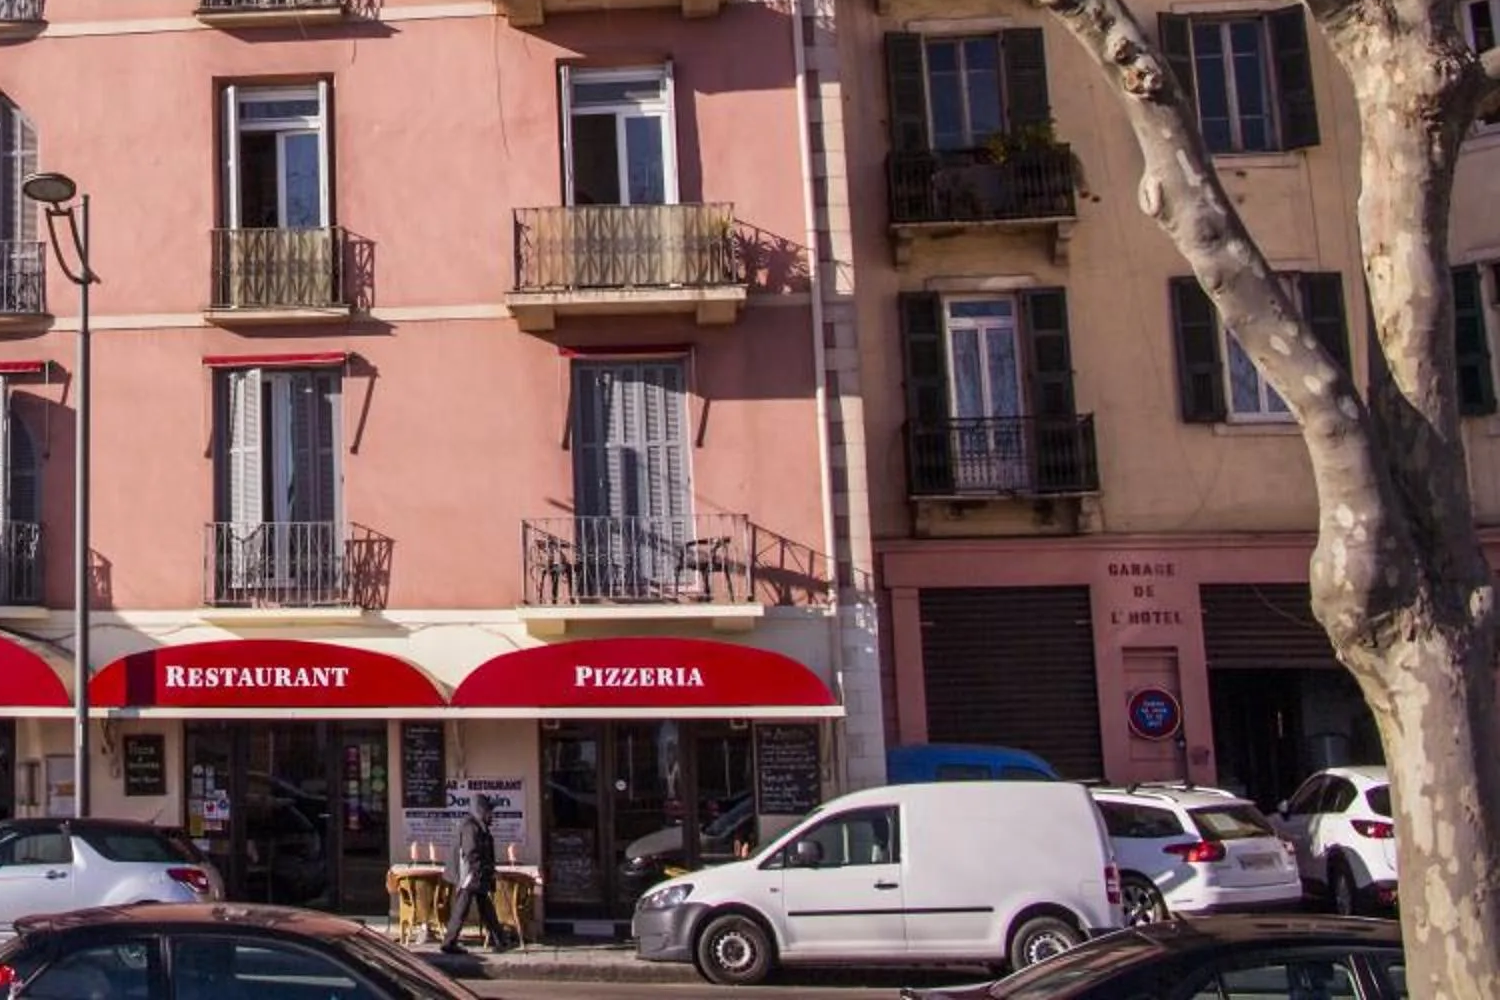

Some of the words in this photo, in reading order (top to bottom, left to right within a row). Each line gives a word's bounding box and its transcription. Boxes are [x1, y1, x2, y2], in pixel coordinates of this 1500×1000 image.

[1108, 562, 1175, 577] GARAGE
[1134, 585, 1154, 598] DE
[165, 665, 349, 687] RESTAURANT
[574, 665, 705, 687] PIZZERIA
